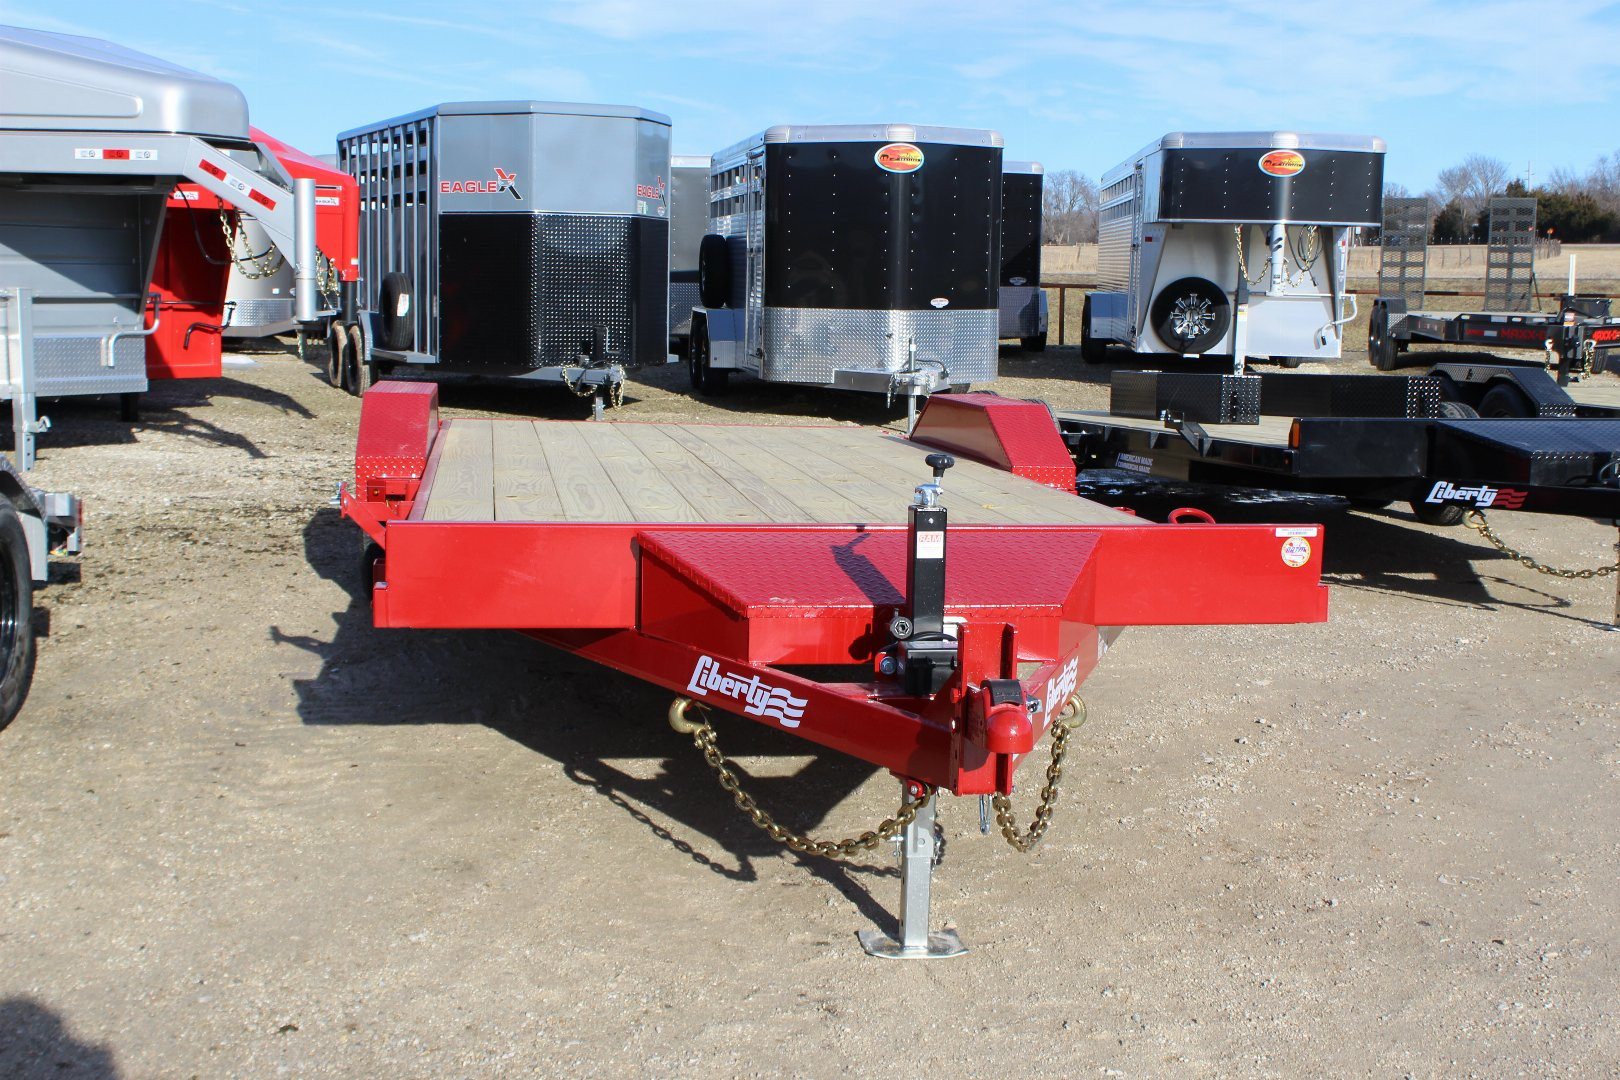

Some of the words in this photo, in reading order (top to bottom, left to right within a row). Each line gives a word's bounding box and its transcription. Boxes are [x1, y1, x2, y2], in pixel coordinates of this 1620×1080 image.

[1425, 481, 1498, 507] Liberty
[919, 532, 942, 543] RAM
[687, 655, 772, 716] Liberty
